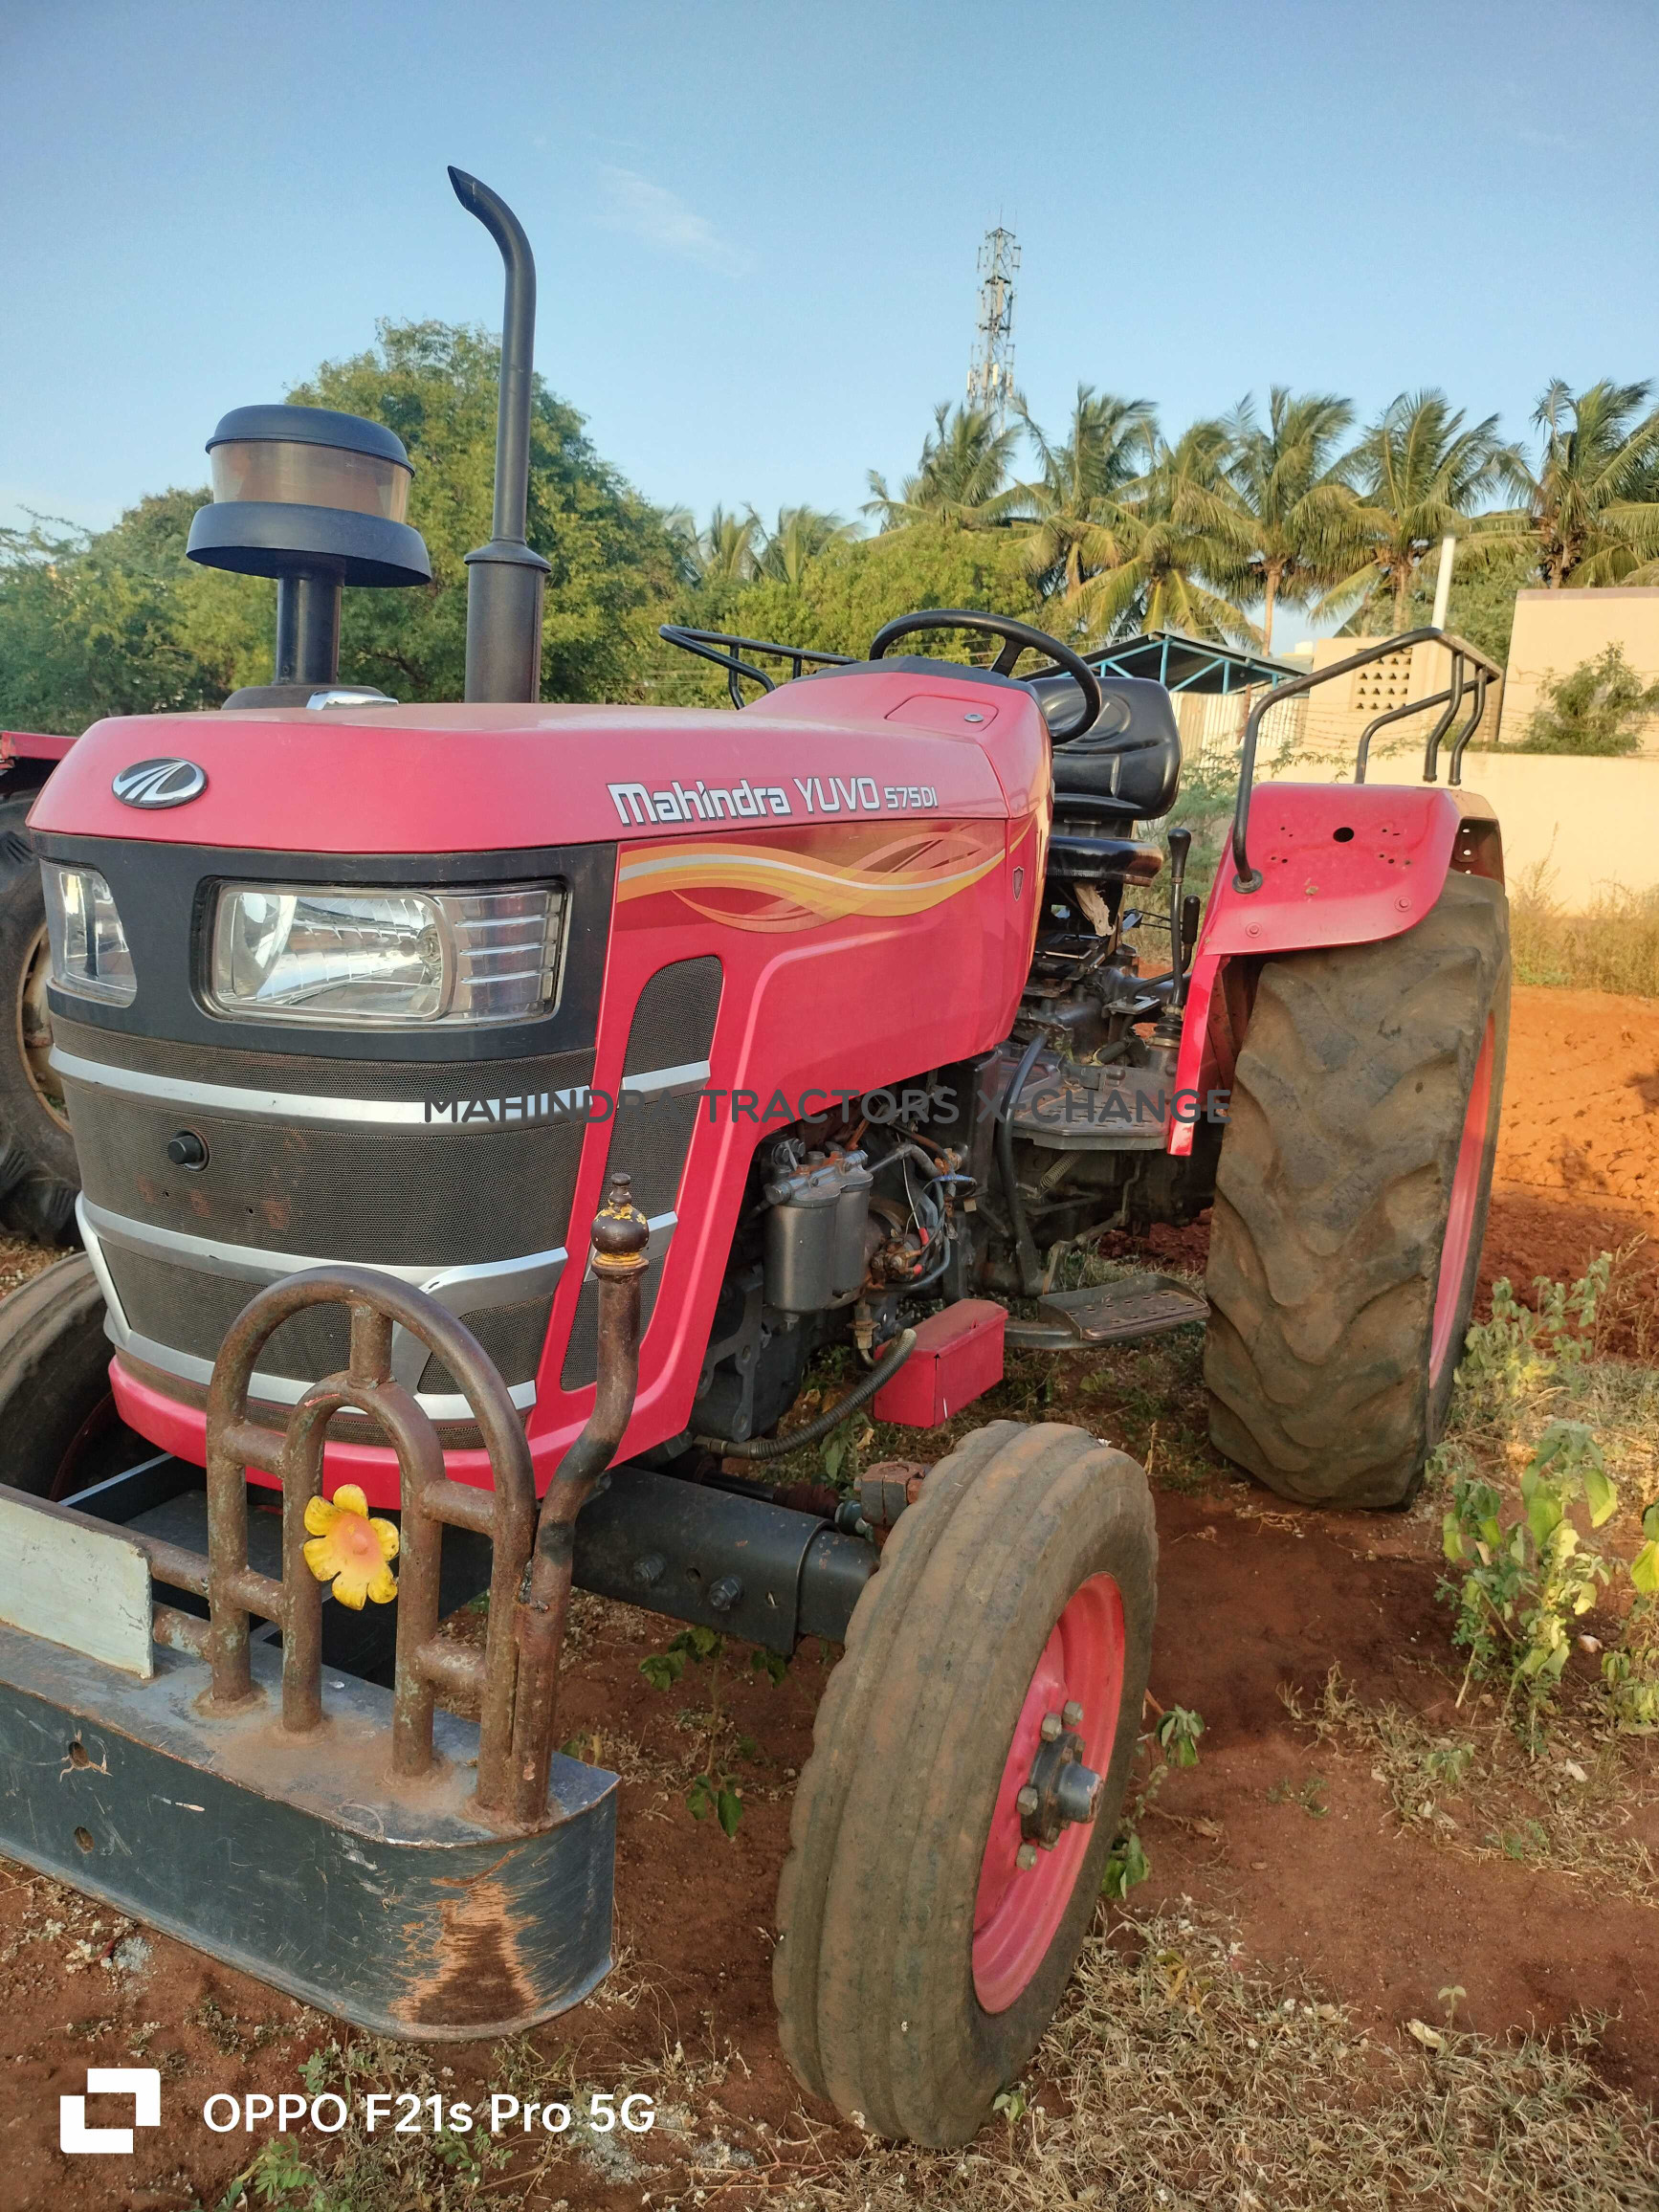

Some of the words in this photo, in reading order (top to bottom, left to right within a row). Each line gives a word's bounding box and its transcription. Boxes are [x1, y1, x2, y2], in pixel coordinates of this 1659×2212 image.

[607, 778, 792, 827] Mahindra
[792, 777, 881, 813] YUVO
[883, 785, 939, 809] 575DI
